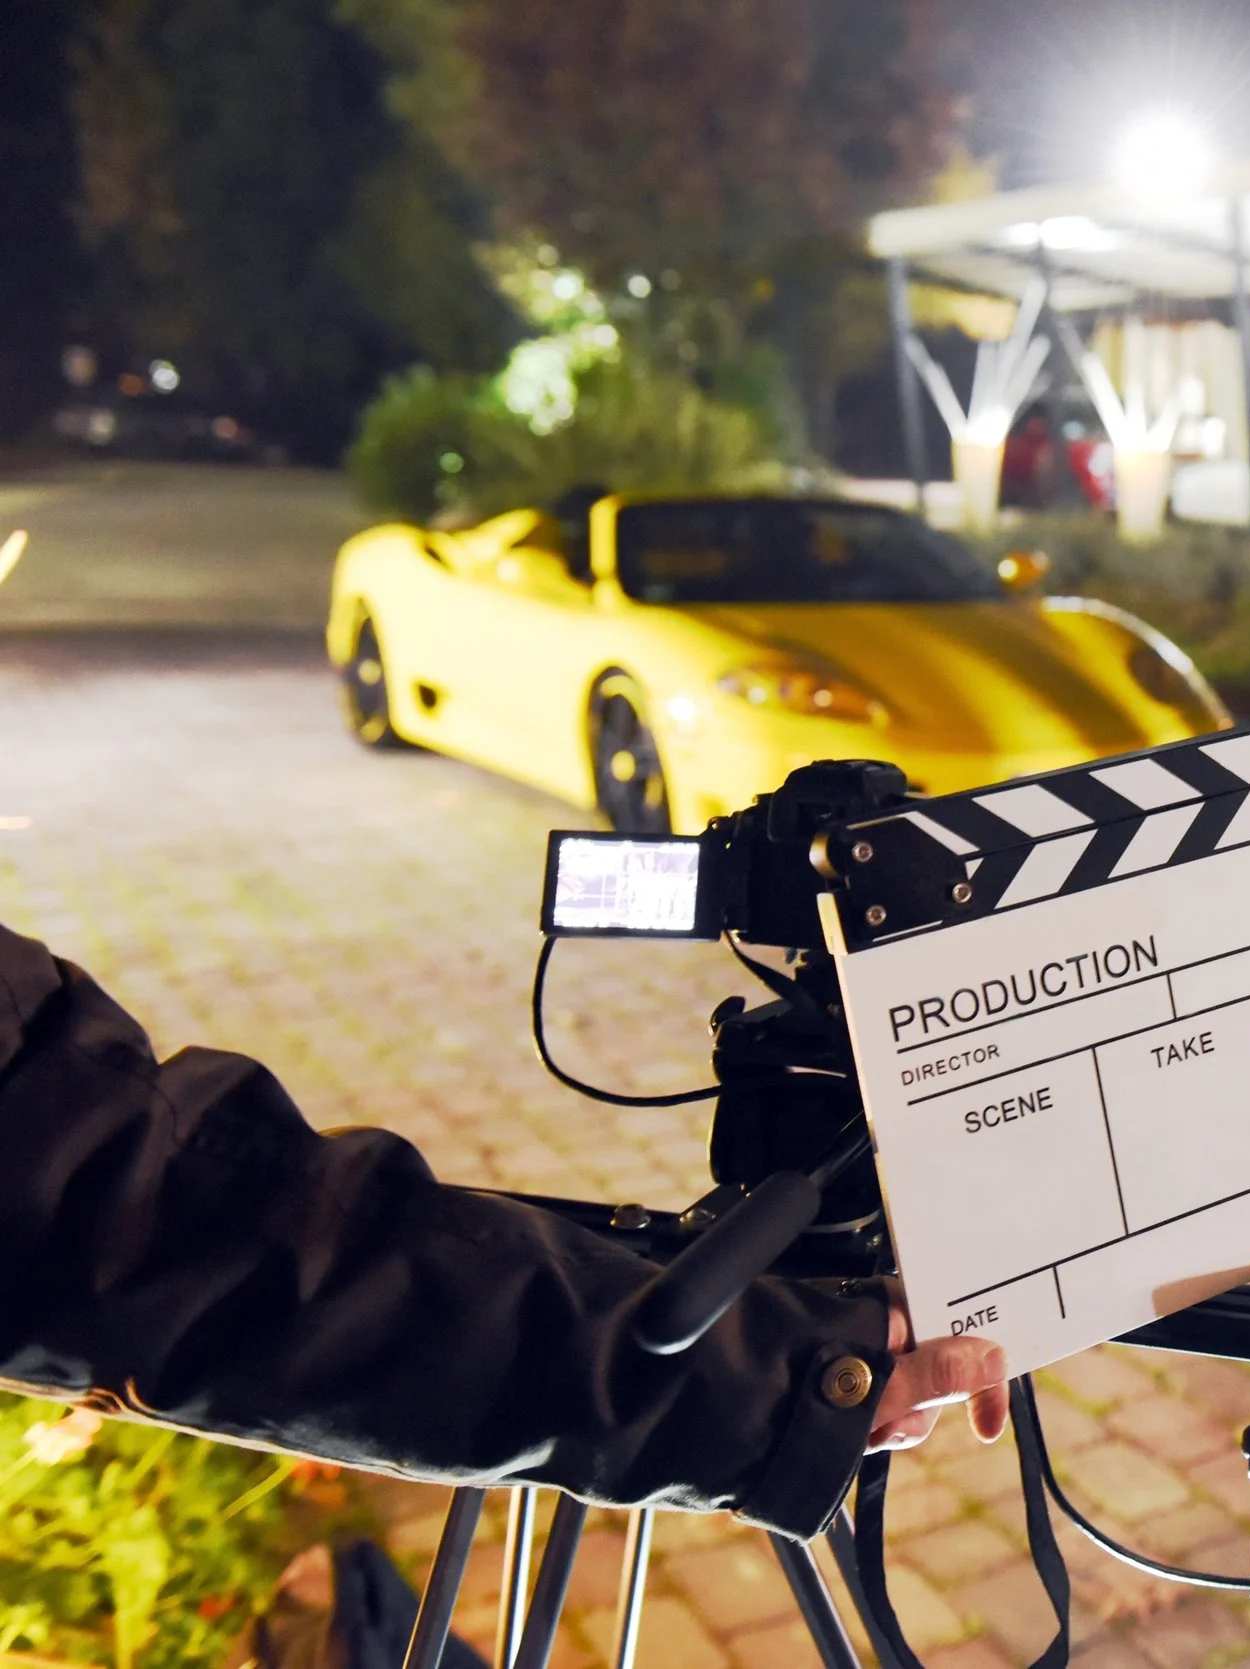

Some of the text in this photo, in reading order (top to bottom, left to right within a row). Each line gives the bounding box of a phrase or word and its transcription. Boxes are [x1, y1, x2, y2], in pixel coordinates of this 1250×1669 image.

[888, 934, 1158, 1043] PRODUCTION
[901, 1044, 1000, 1086] DIRECTOR
[1150, 1031, 1215, 1069] TAKE
[964, 1086, 1054, 1134] SCENE
[950, 1305, 999, 1337] DATE
